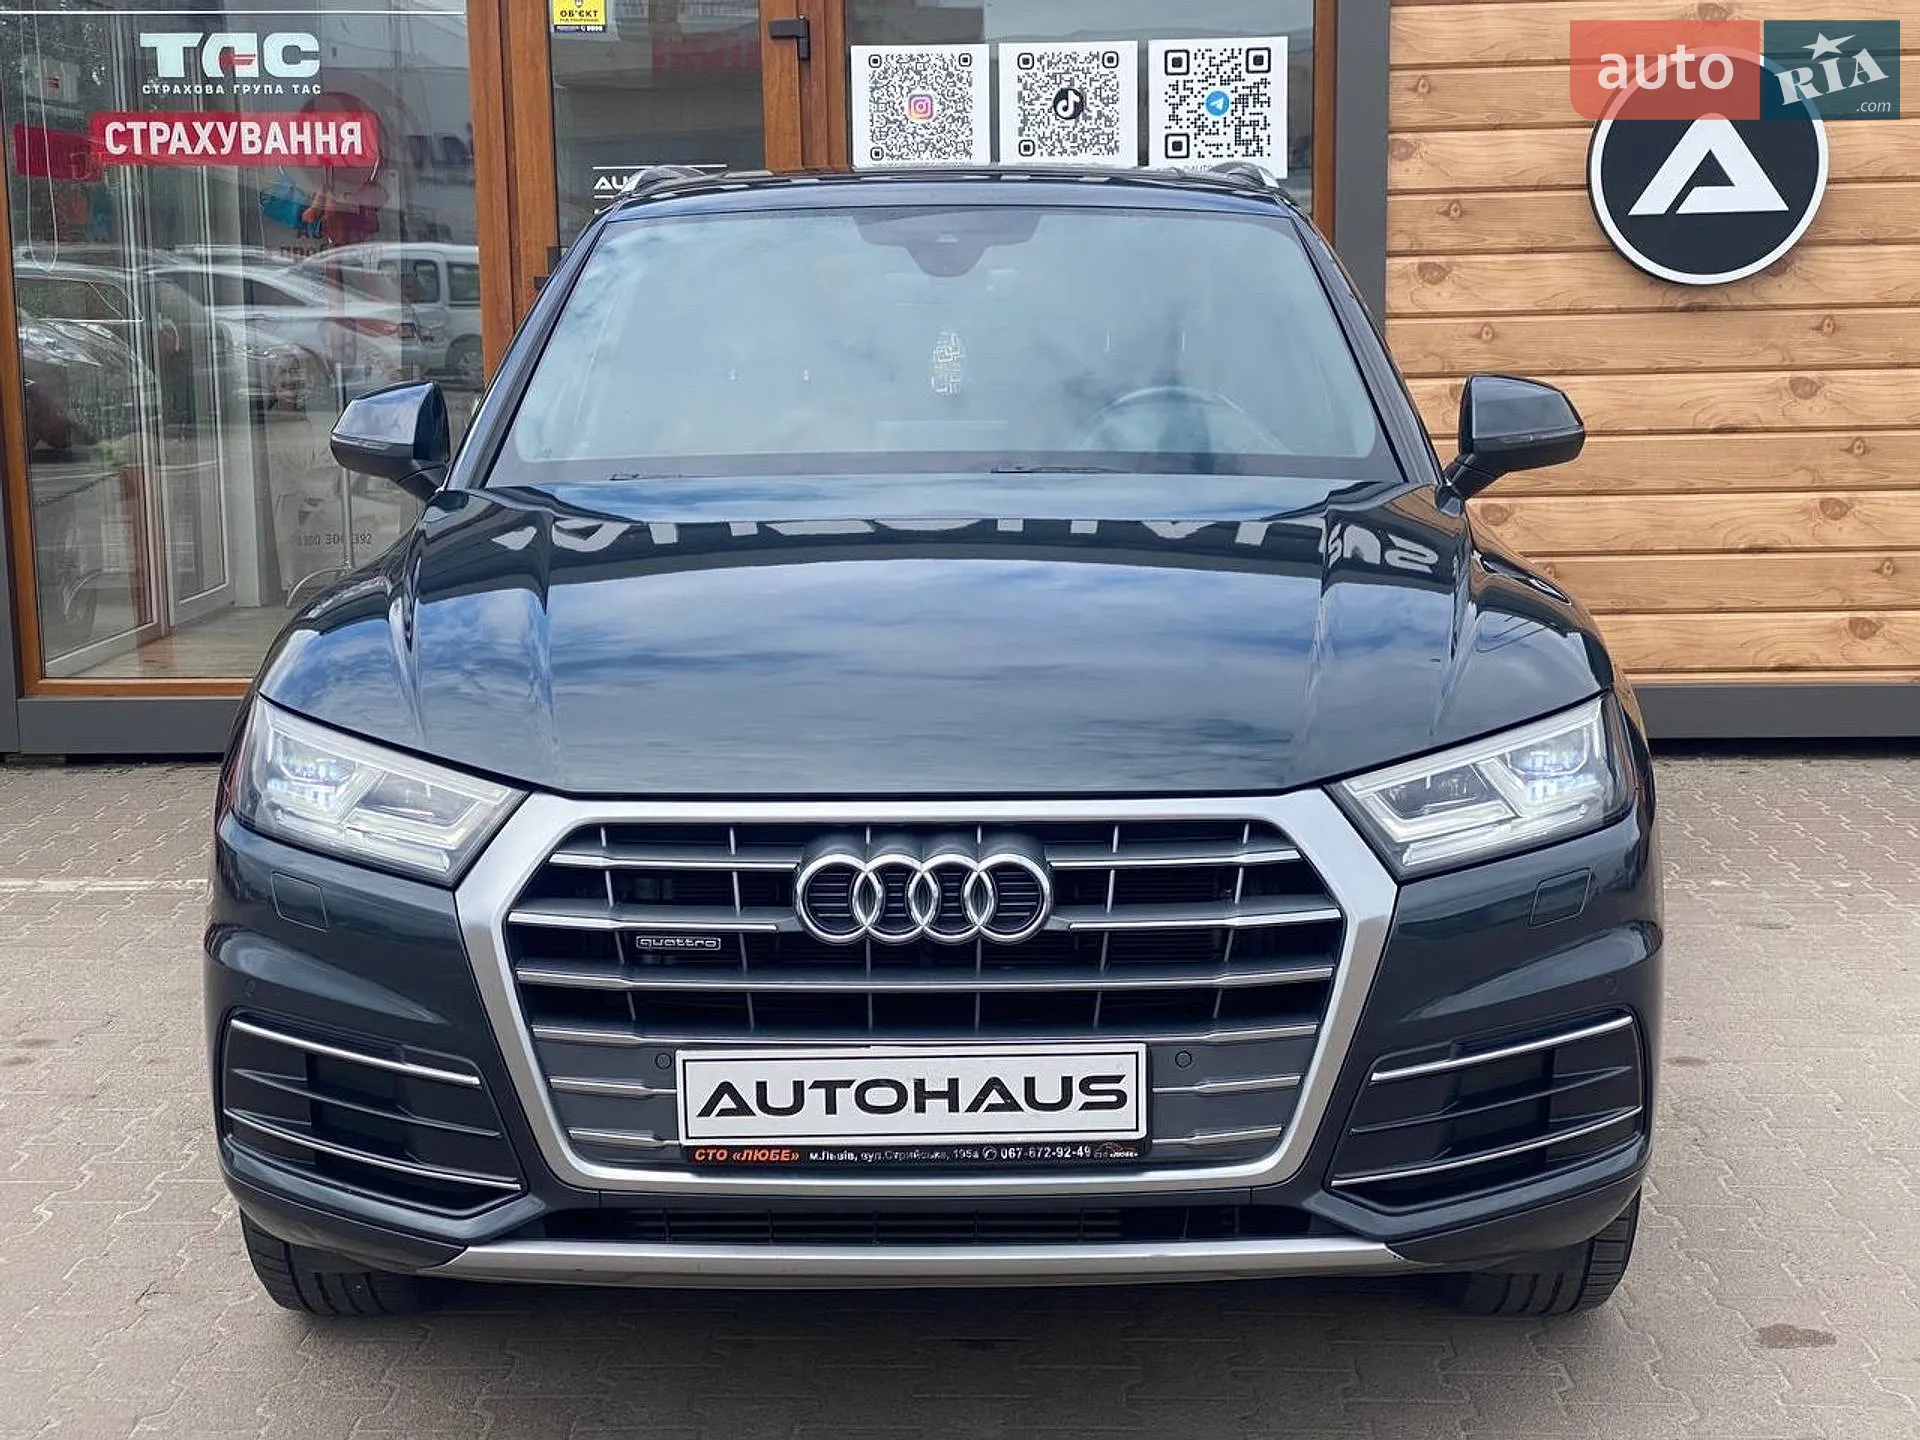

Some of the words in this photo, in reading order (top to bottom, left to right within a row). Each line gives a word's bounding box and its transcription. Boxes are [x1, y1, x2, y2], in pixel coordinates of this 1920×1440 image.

[142, 84, 225, 96] СТРАХОВА
[233, 84, 284, 95] ГРУПА
[292, 83, 322, 95] ТАС
[105, 121, 363, 156] СТРАХУВАННЯ
[639, 938, 718, 949] quattro
[695, 1073, 1129, 1118] AUTOHAUS
[694, 1148, 729, 1161] СТО
[731, 1148, 800, 1161] «ЛЮБЕ»
[1000, 1145, 1093, 1160] 067-672-92-49
